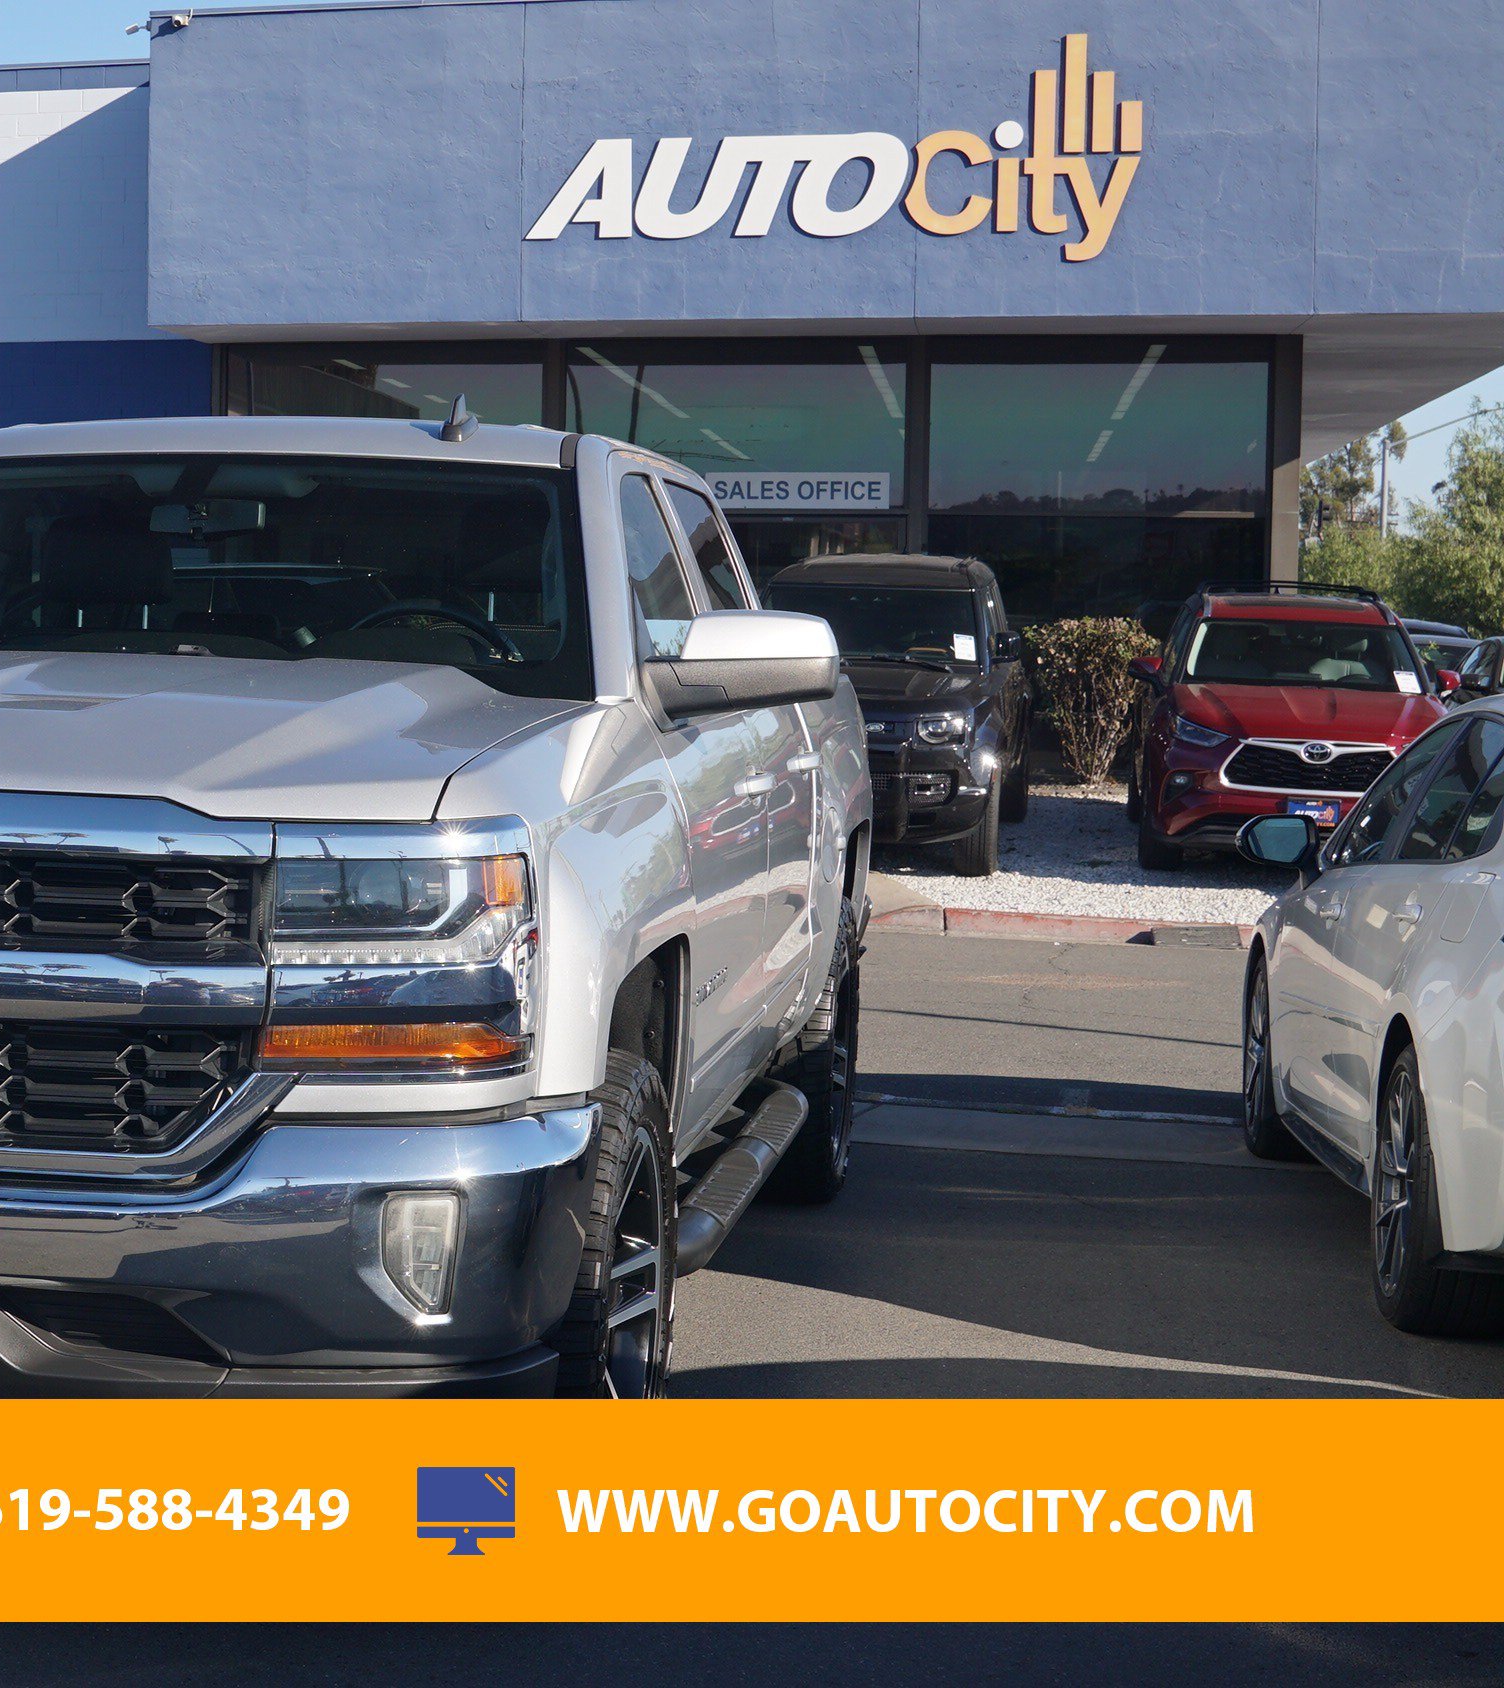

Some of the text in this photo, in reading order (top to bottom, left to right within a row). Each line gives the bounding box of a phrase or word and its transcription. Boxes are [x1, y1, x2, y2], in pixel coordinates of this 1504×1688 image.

[524, 70, 1142, 261] AUTOCity
[714, 480, 882, 500] SALES OFFICE
